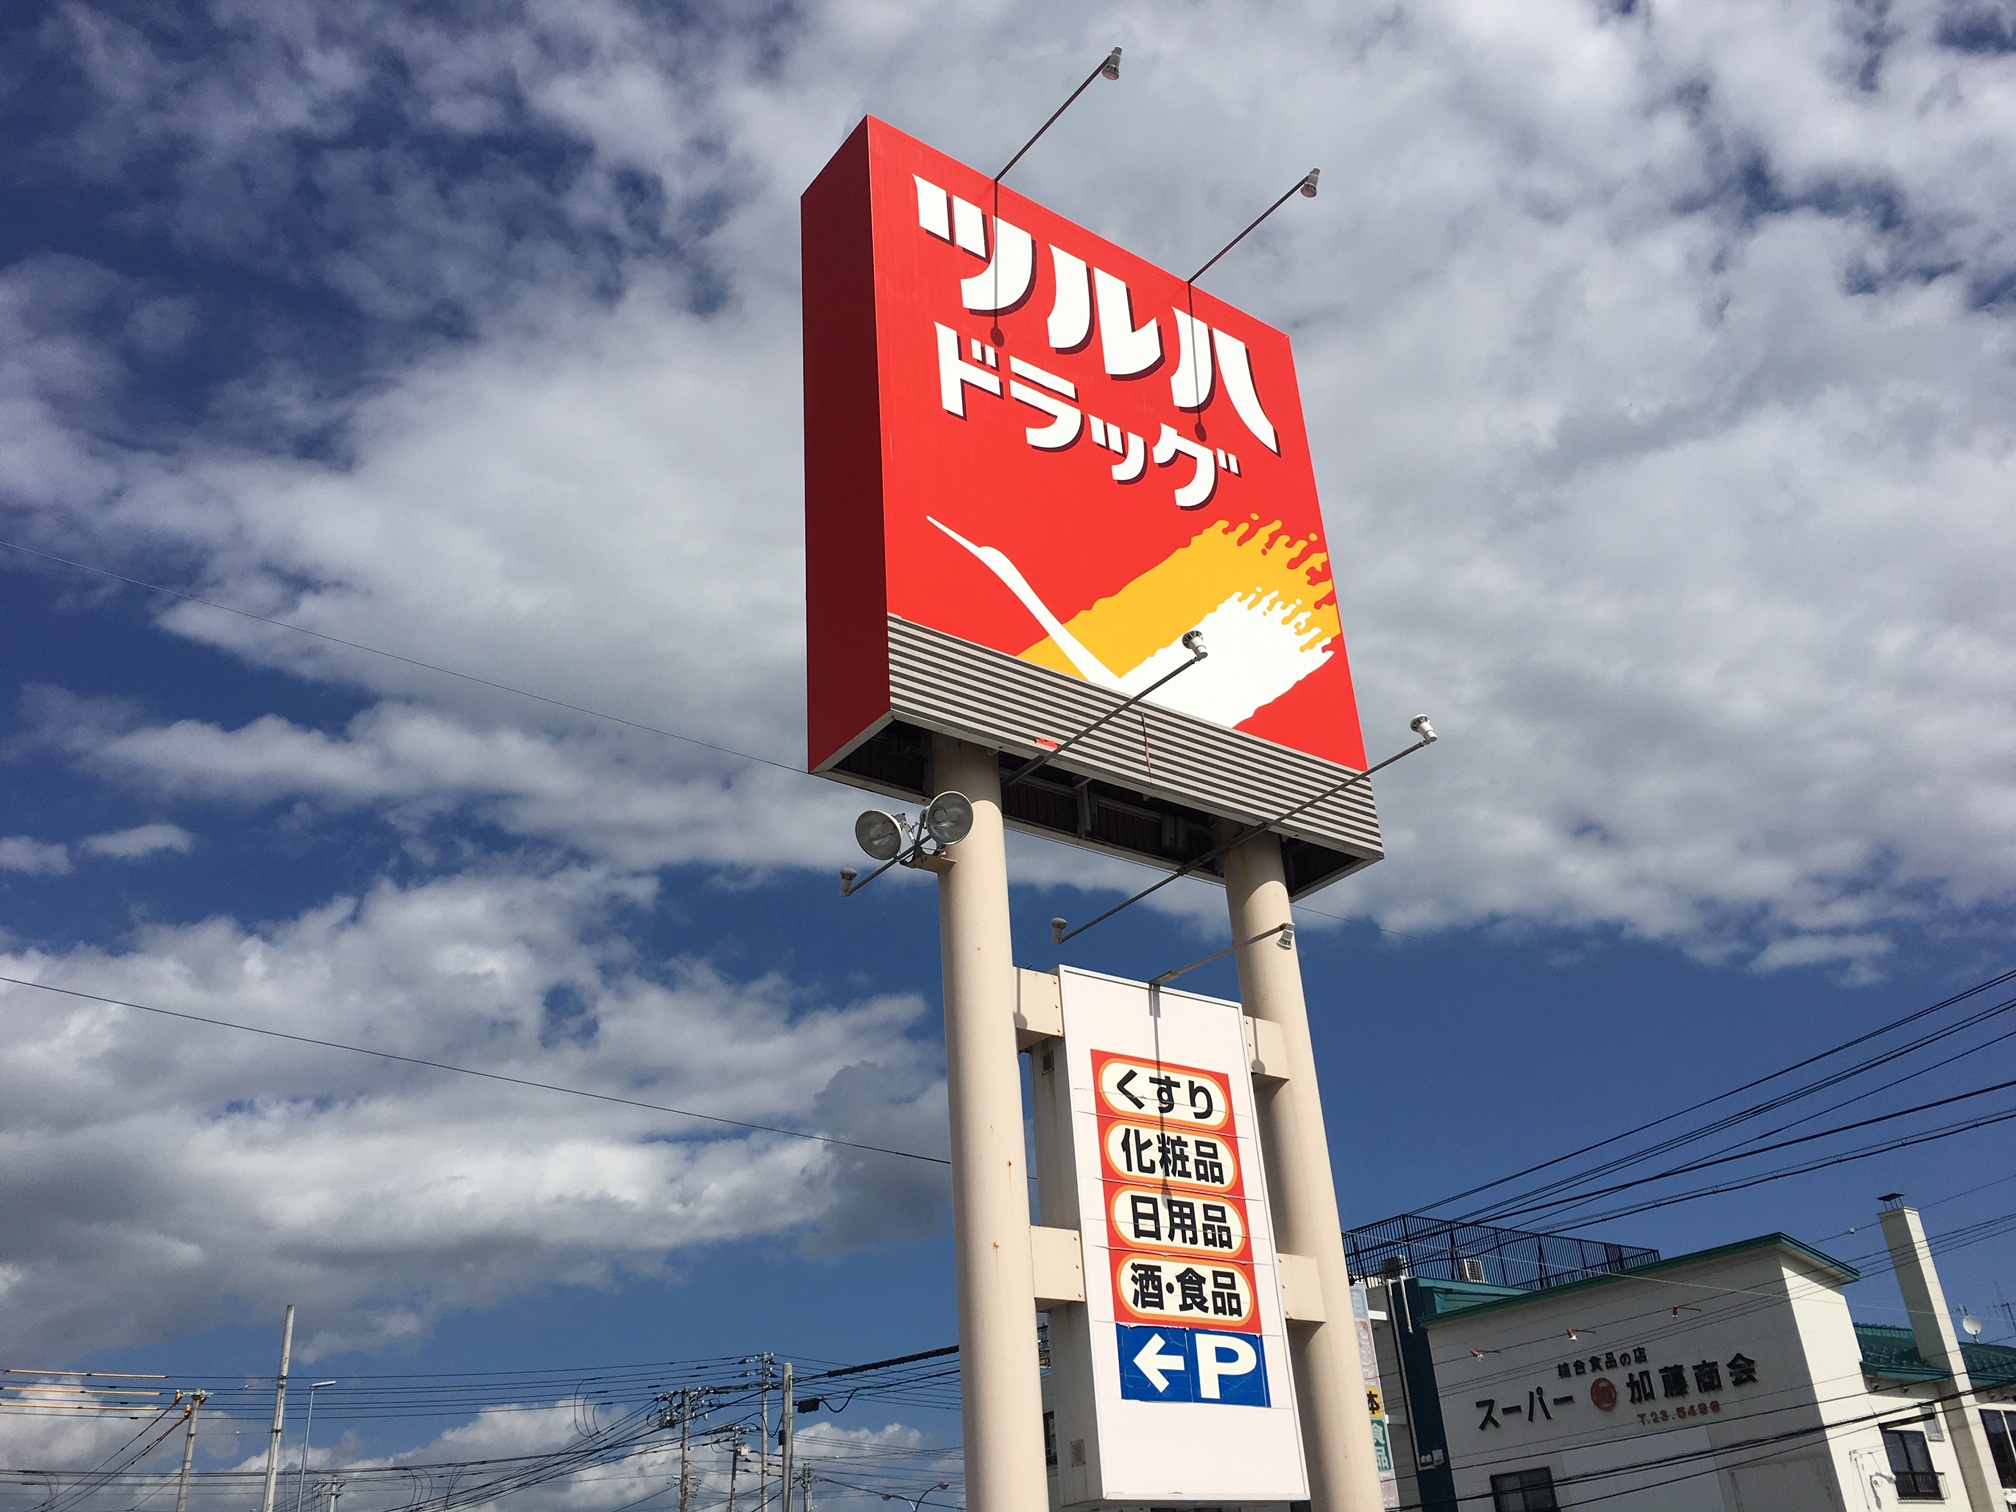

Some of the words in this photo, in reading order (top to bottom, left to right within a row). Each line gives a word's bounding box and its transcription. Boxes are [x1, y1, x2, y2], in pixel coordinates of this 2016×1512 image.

[912, 173, 1280, 455] ツルハ
[934, 320, 1241, 508] ドラッグ
[1116, 1069, 1214, 1120] くすり
[1121, 1128, 1225, 1185] 化粧品
[1131, 1195, 1233, 1249] 日用品
[1131, 1262, 1243, 1317] 酒・食品
[1195, 1333, 1257, 1399] P
[1475, 1386, 1576, 1431] スーパー
[1626, 1352, 1758, 1404] 加藤商会
